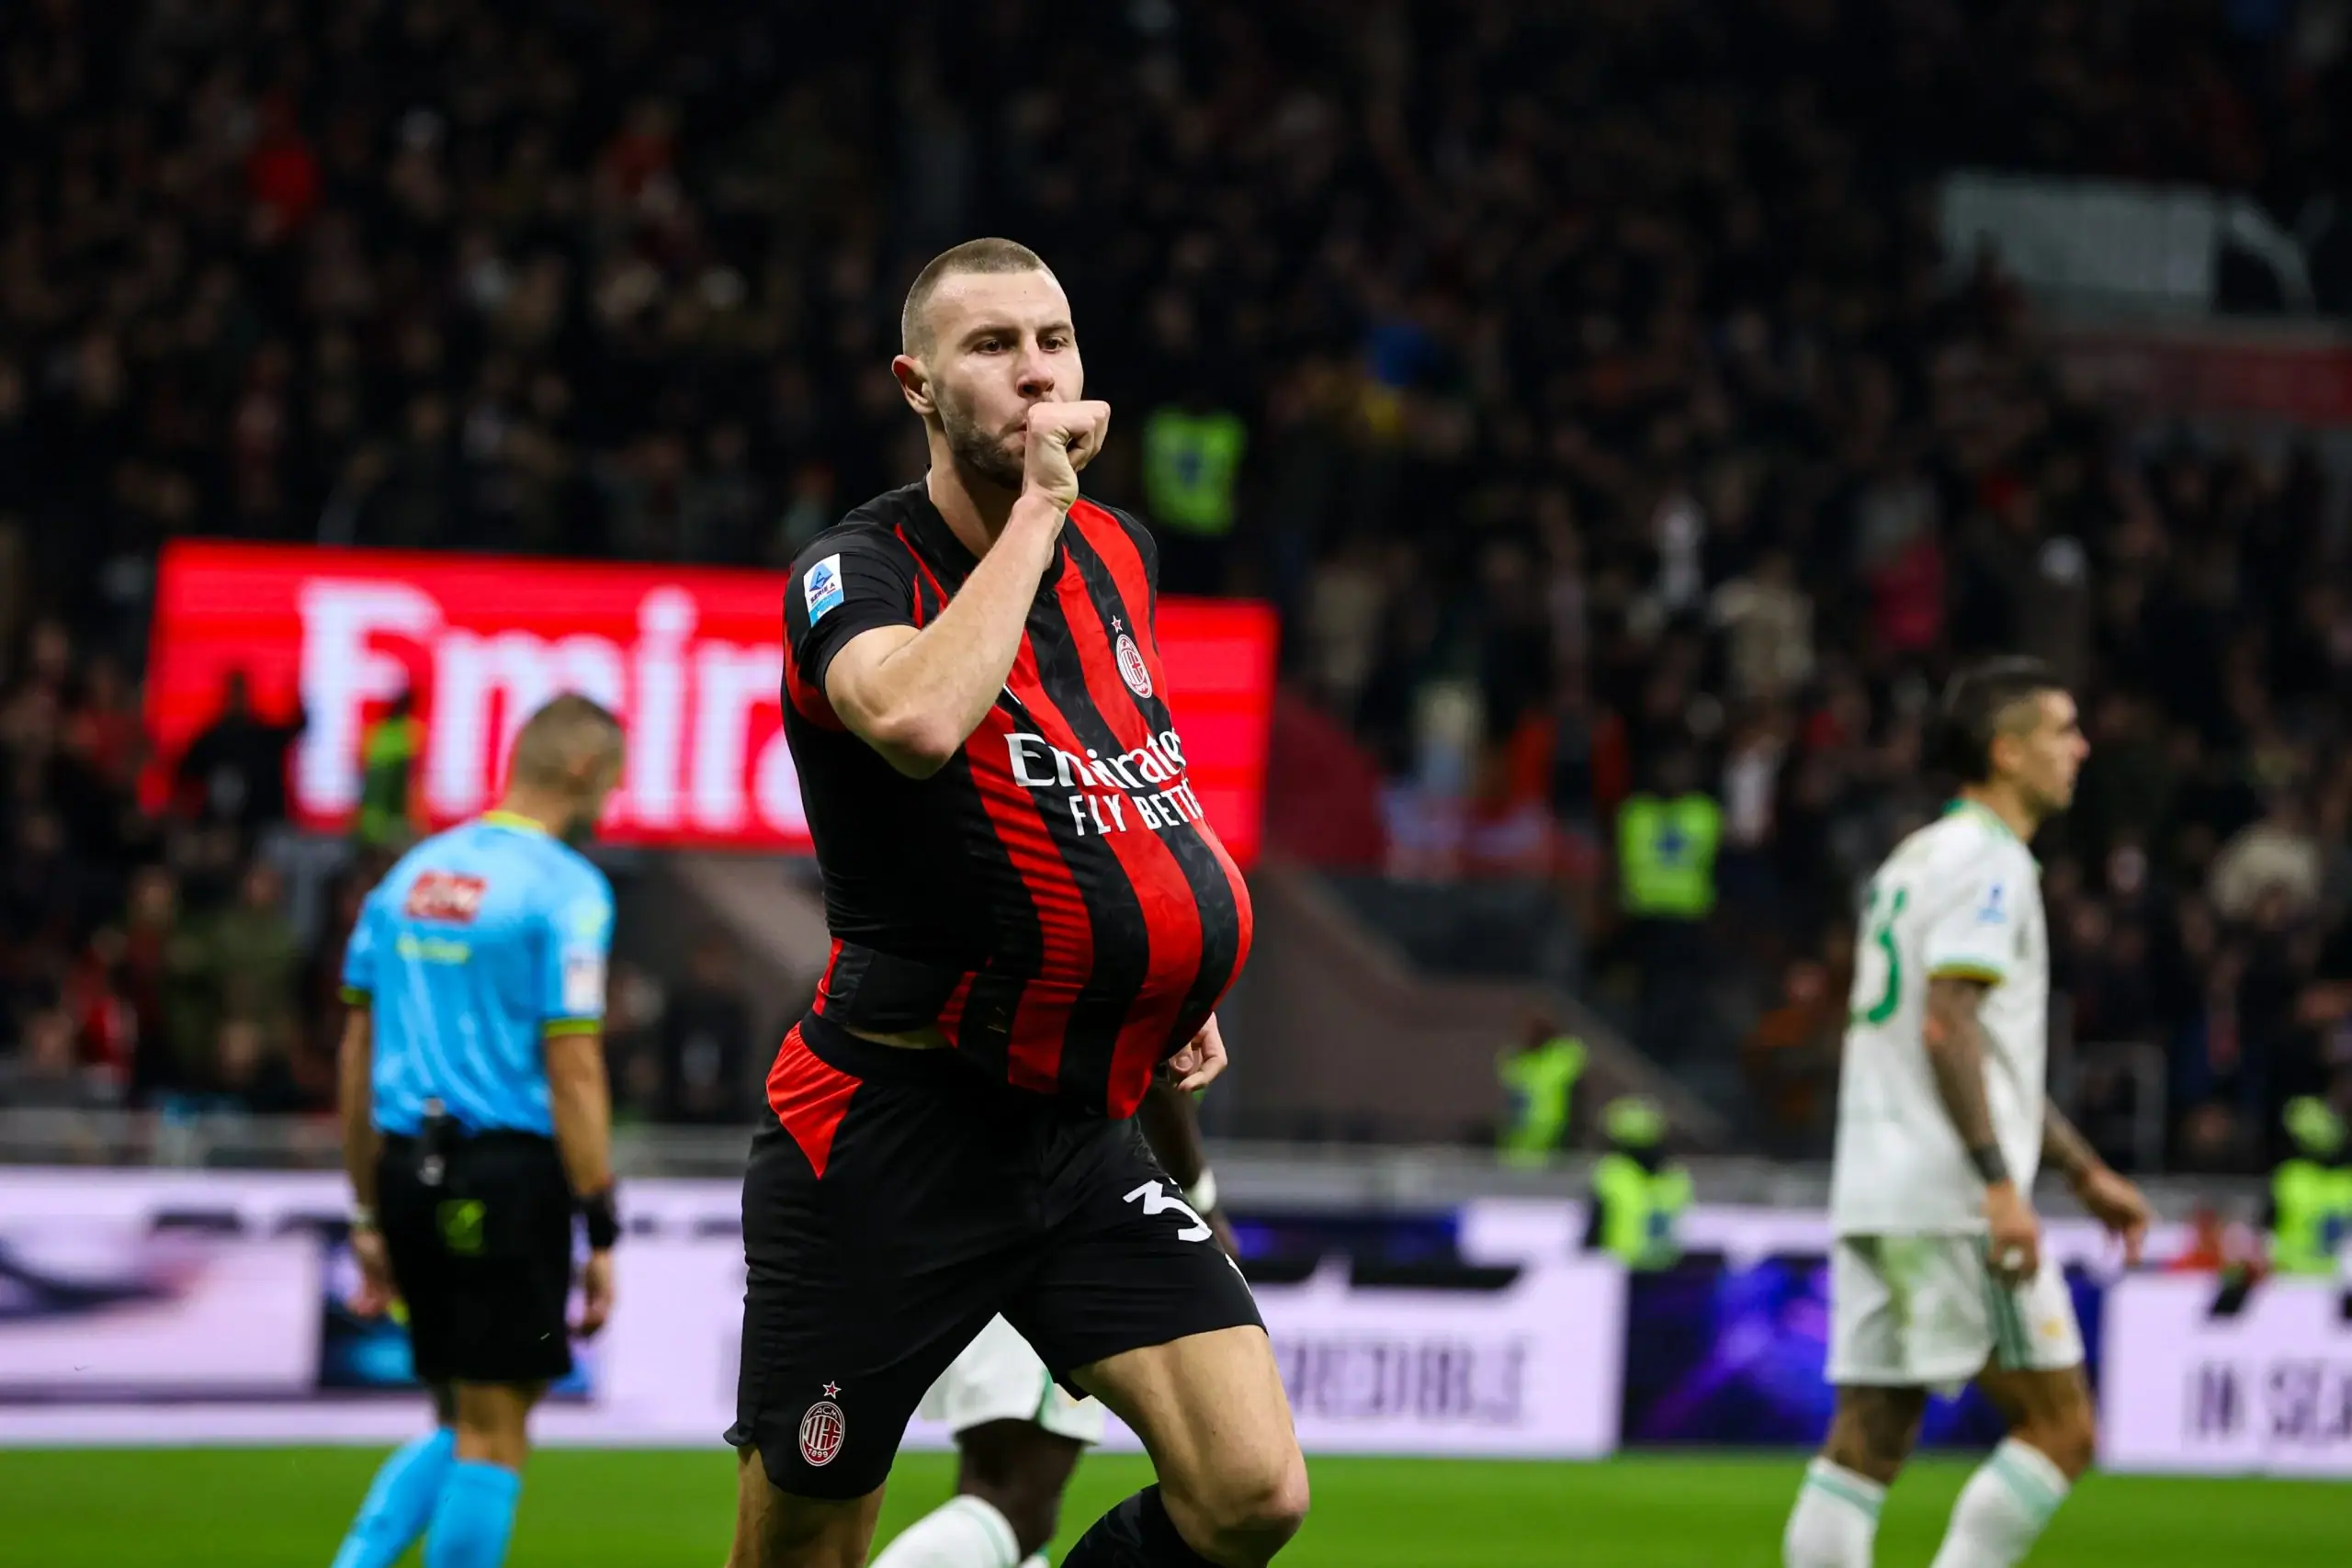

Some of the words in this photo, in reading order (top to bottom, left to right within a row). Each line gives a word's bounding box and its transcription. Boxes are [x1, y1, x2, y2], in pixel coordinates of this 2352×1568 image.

[1003, 728, 1187, 789] Emirate
[1069, 794, 1127, 836] FLY
[1849, 887, 1907, 1027] 3
[1122, 1177, 1213, 1243] 3
[814, 1406, 838, 1419] ACM
[808, 1449, 829, 1458] 1899
